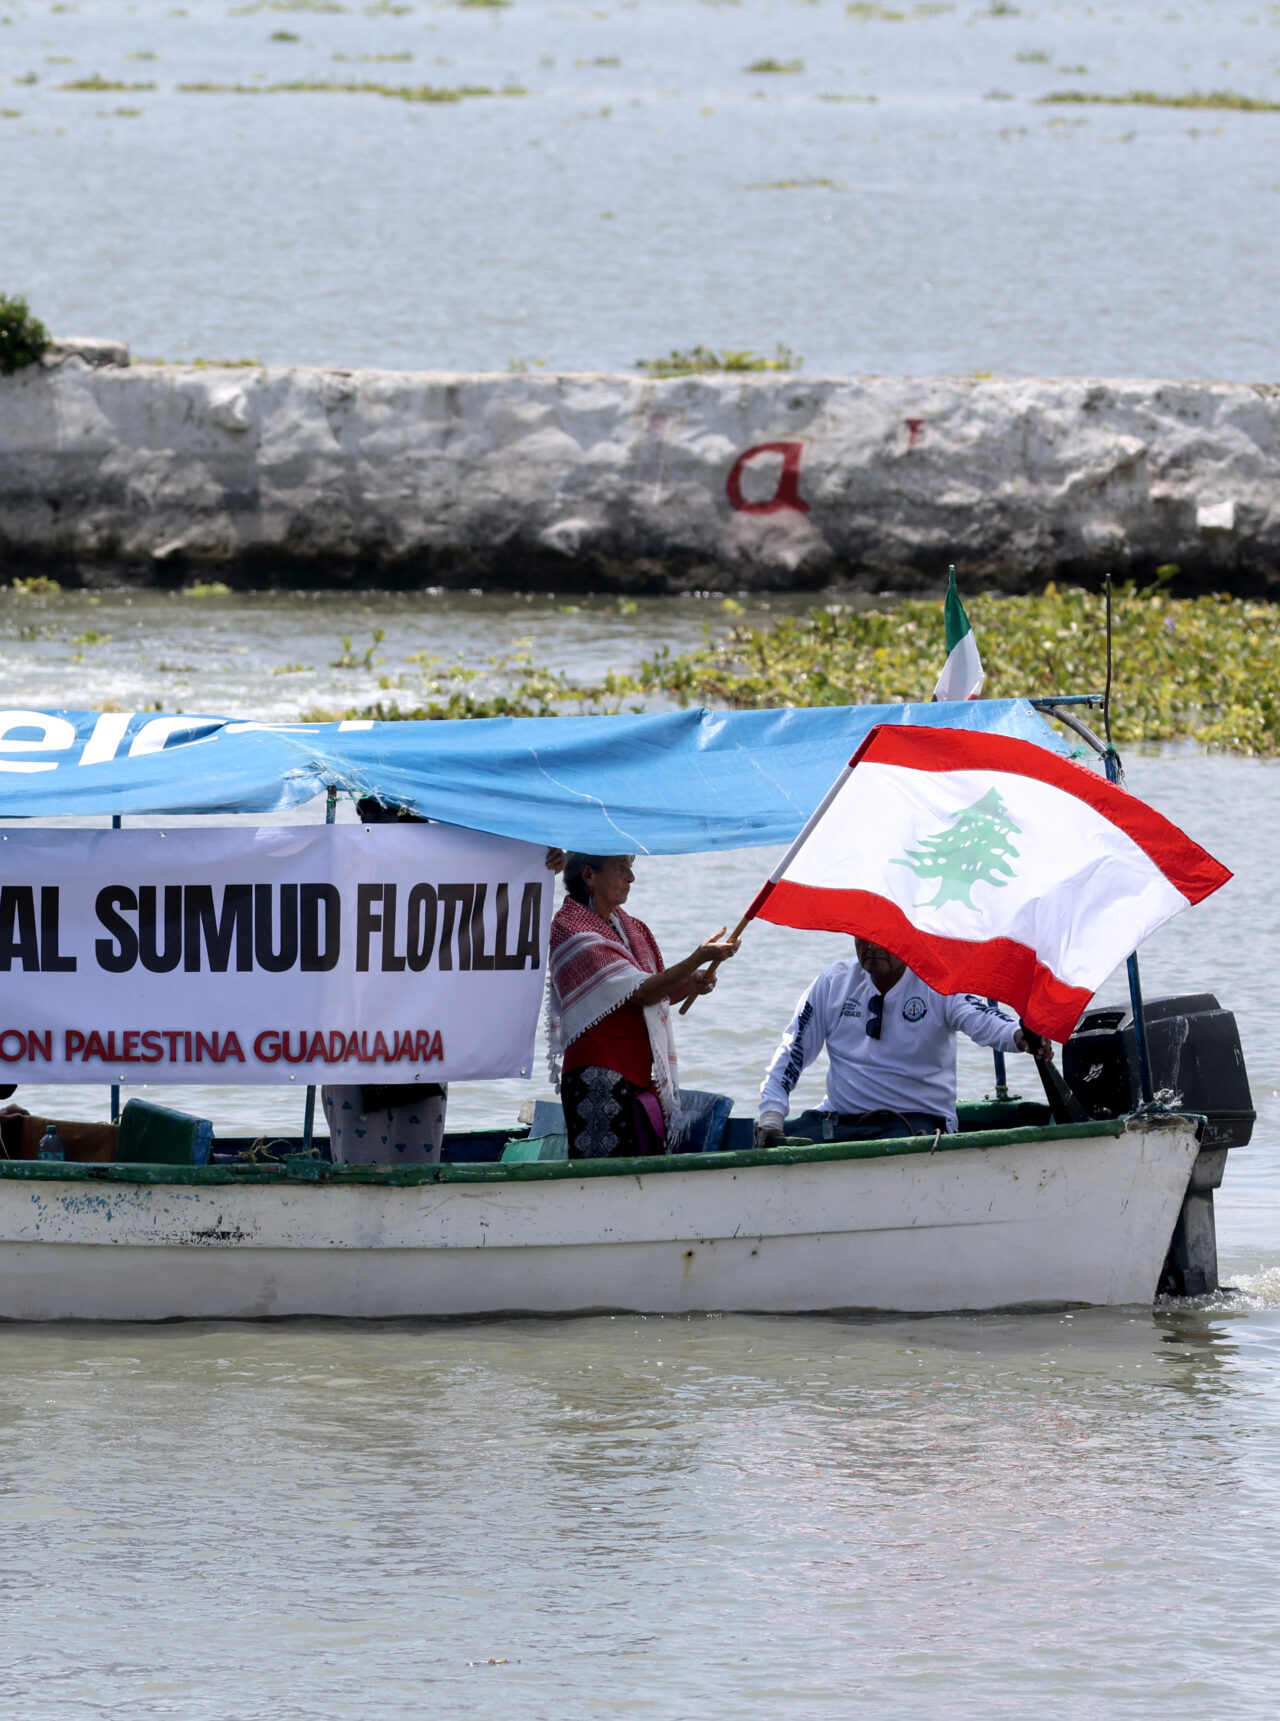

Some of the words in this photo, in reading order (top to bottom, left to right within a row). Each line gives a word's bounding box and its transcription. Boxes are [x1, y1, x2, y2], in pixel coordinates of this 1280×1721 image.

[94, 882, 341, 974] SUMUD
[356, 881, 543, 973] FLOTILLA
[65, 1029, 246, 1063] PALESTINA
[253, 1028, 445, 1063] GUADALAJARA
